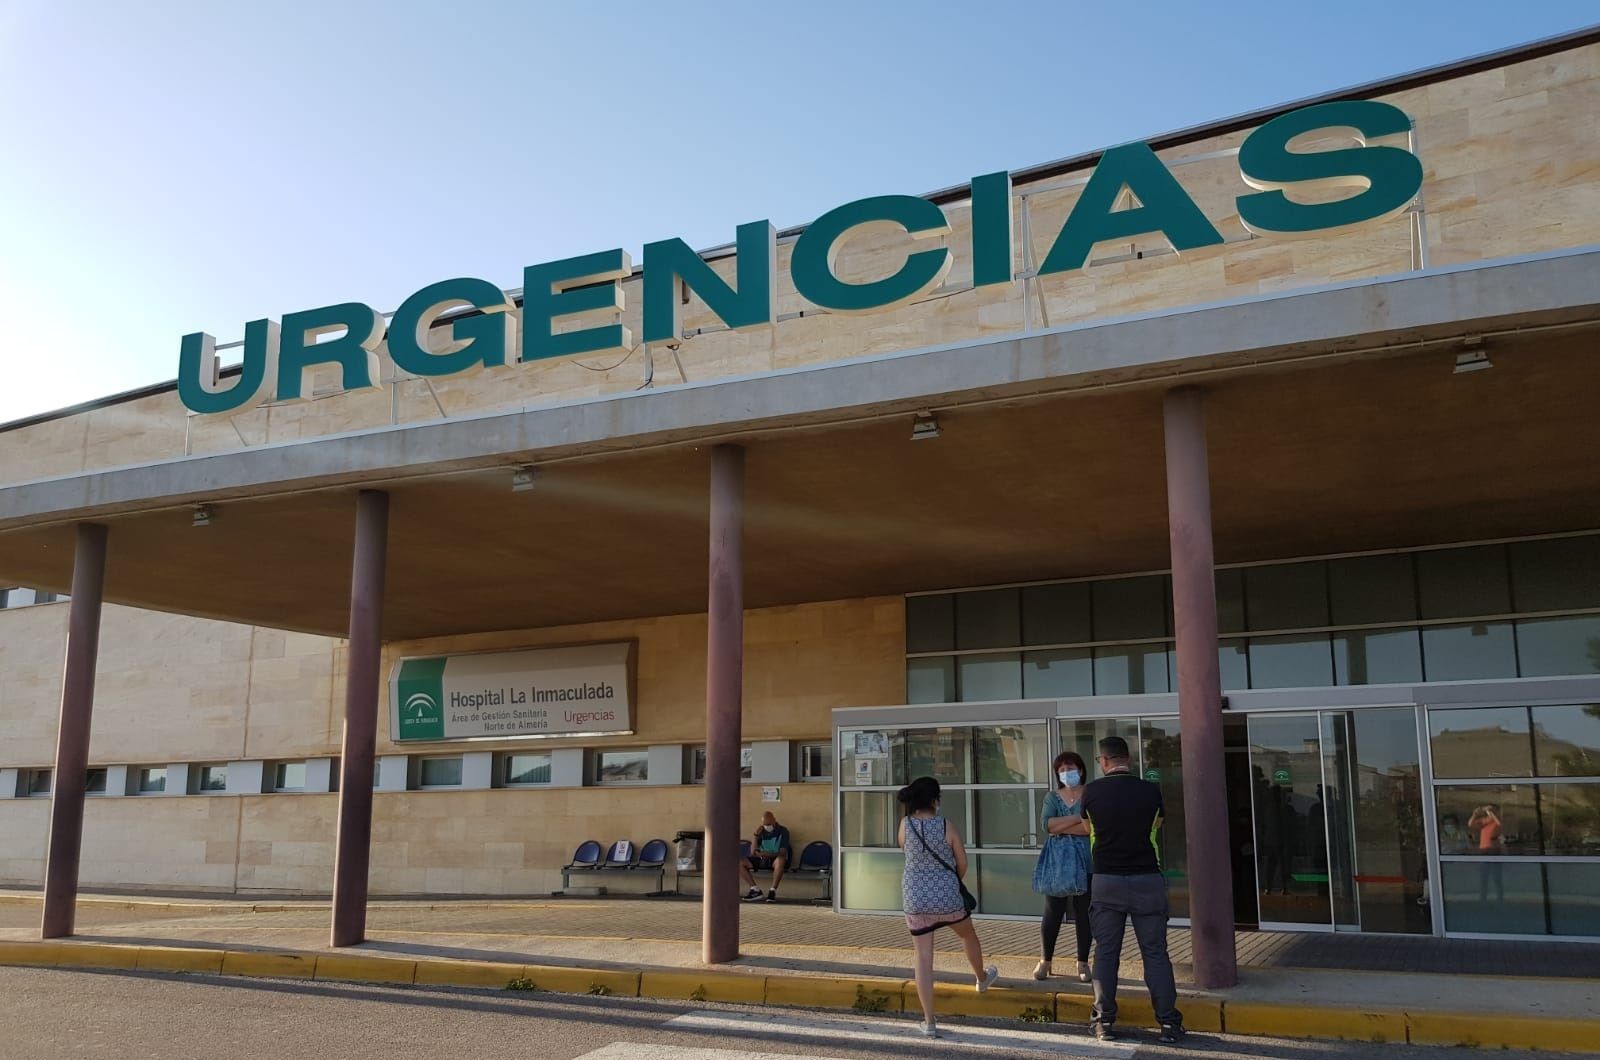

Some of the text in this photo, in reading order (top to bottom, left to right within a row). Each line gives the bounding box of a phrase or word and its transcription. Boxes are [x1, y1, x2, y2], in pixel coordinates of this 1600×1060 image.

[178, 99, 1424, 414] URGENCIAS
[450, 681, 614, 711] Hospital La Inmaculada
[451, 711, 469, 723] Área
[470, 712, 480, 721] de
[481, 710, 511, 721] Gestión
[513, 708, 548, 720] Sanitaria
[564, 708, 616, 725] Urgencias
[484, 718, 548, 732] Norte de Almería
